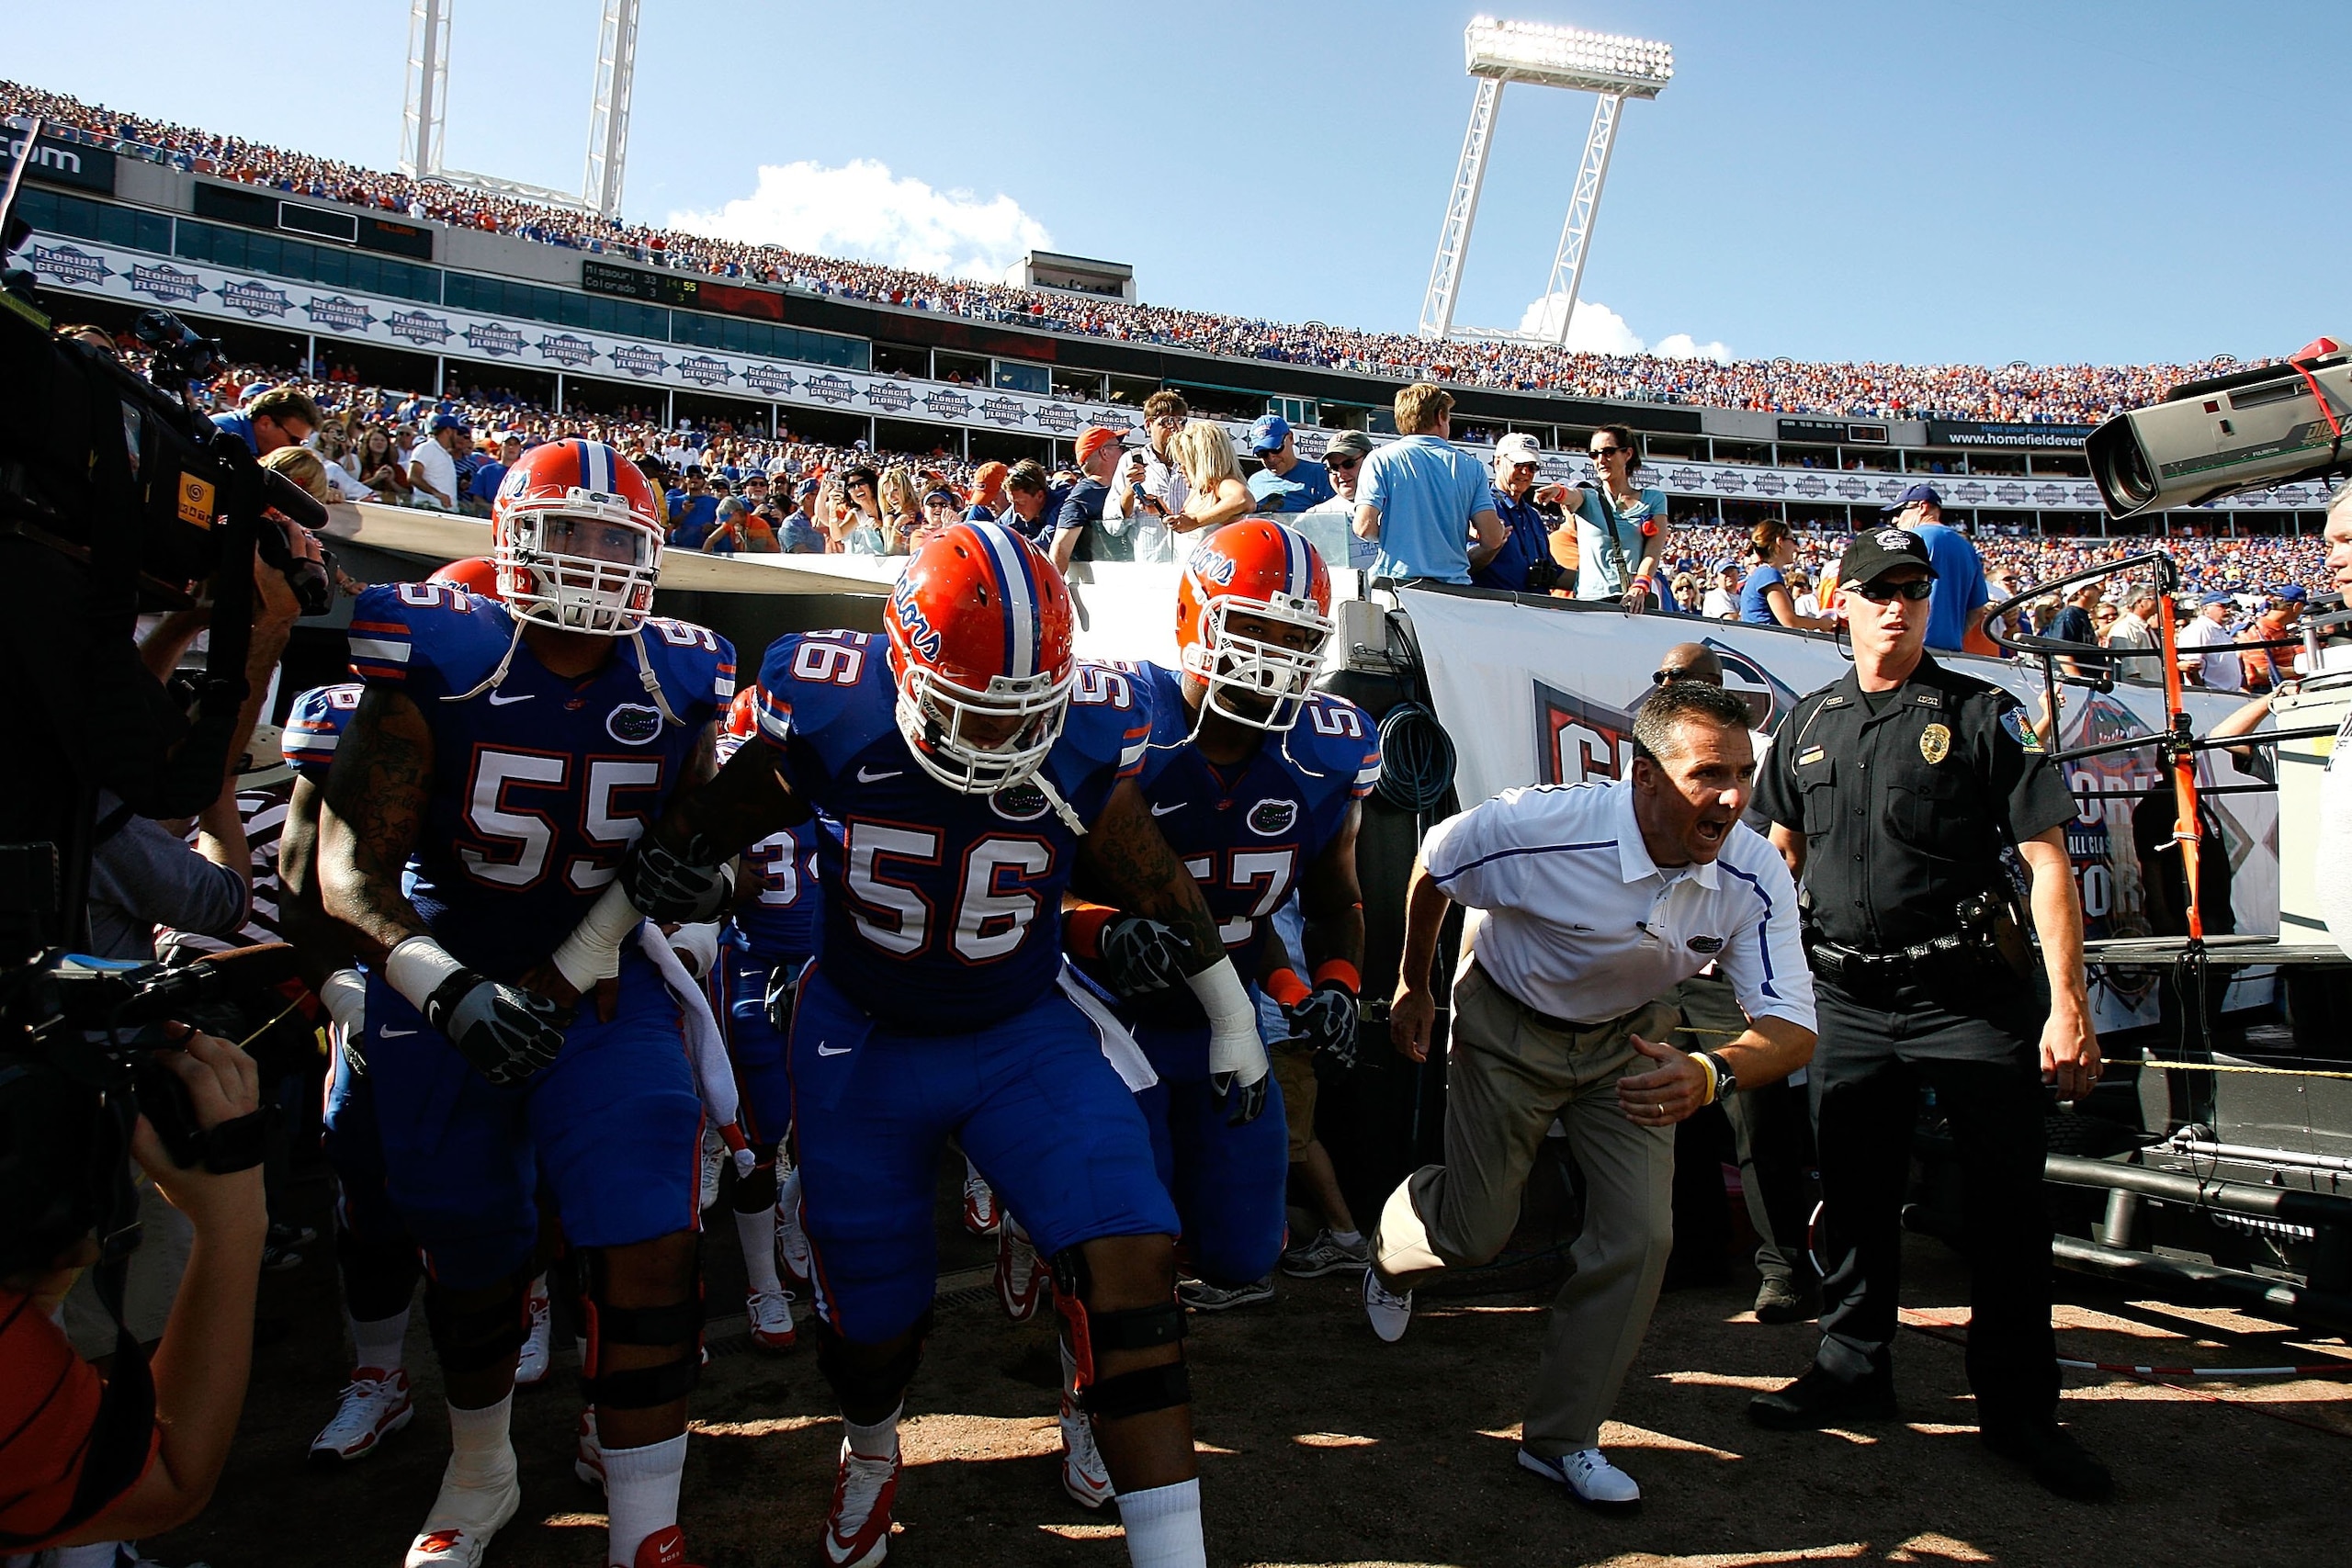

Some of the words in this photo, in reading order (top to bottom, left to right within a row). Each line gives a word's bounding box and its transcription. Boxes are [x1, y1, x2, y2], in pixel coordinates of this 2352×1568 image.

[36, 247, 100, 268] FLORIDA
[36, 262, 99, 282] GEORGIA
[135, 266, 194, 285] GEORGIA
[586, 265, 634, 281] Missouri
[644, 275, 657, 285] 33
[135, 280, 194, 299] FLORIDA
[585, 276, 637, 294] Colorado
[226, 283, 281, 301] FLORIDA
[226, 298, 281, 314] GEORGIA
[312, 299, 365, 315] GEORGIA
[312, 312, 364, 328] FLORIDA
[394, 313, 443, 329] FLORIDA
[393, 326, 443, 342] GEORGIA
[471, 326, 517, 340] GEORGIA
[470, 338, 517, 352] FLORIDA
[545, 336, 589, 351] FLORIDA
[545, 348, 589, 362] GEORGIA
[616, 348, 660, 361] GEORGIA
[616, 360, 660, 373] FLORIDA
[684, 358, 726, 371] FLORIDA
[684, 369, 726, 382] GEORGIA
[749, 368, 788, 380] GEORGIA
[749, 378, 788, 390] FLORIDA
[810, 377, 849, 389] FLORIDA
[810, 388, 849, 400] GEORGIA
[871, 386, 909, 397] GEORGIA
[930, 392, 965, 404] FLORIDA
[871, 396, 909, 407] FLORIDA
[986, 400, 1021, 412] GEORGIA
[930, 403, 966, 414] GEORGIA
[1040, 407, 1075, 418] FLORIDA
[986, 411, 1021, 423] FLORIDA
[1040, 418, 1076, 429] GEORGIA
[1094, 413, 1128, 423] GEORGIA
[2006, 426, 2025, 434] your
[1301, 437, 1328, 446] GEORGI
[2253, 446, 2280, 457] FUJINON
[458, 746, 662, 893] 55
[845, 819, 1054, 964] 56
